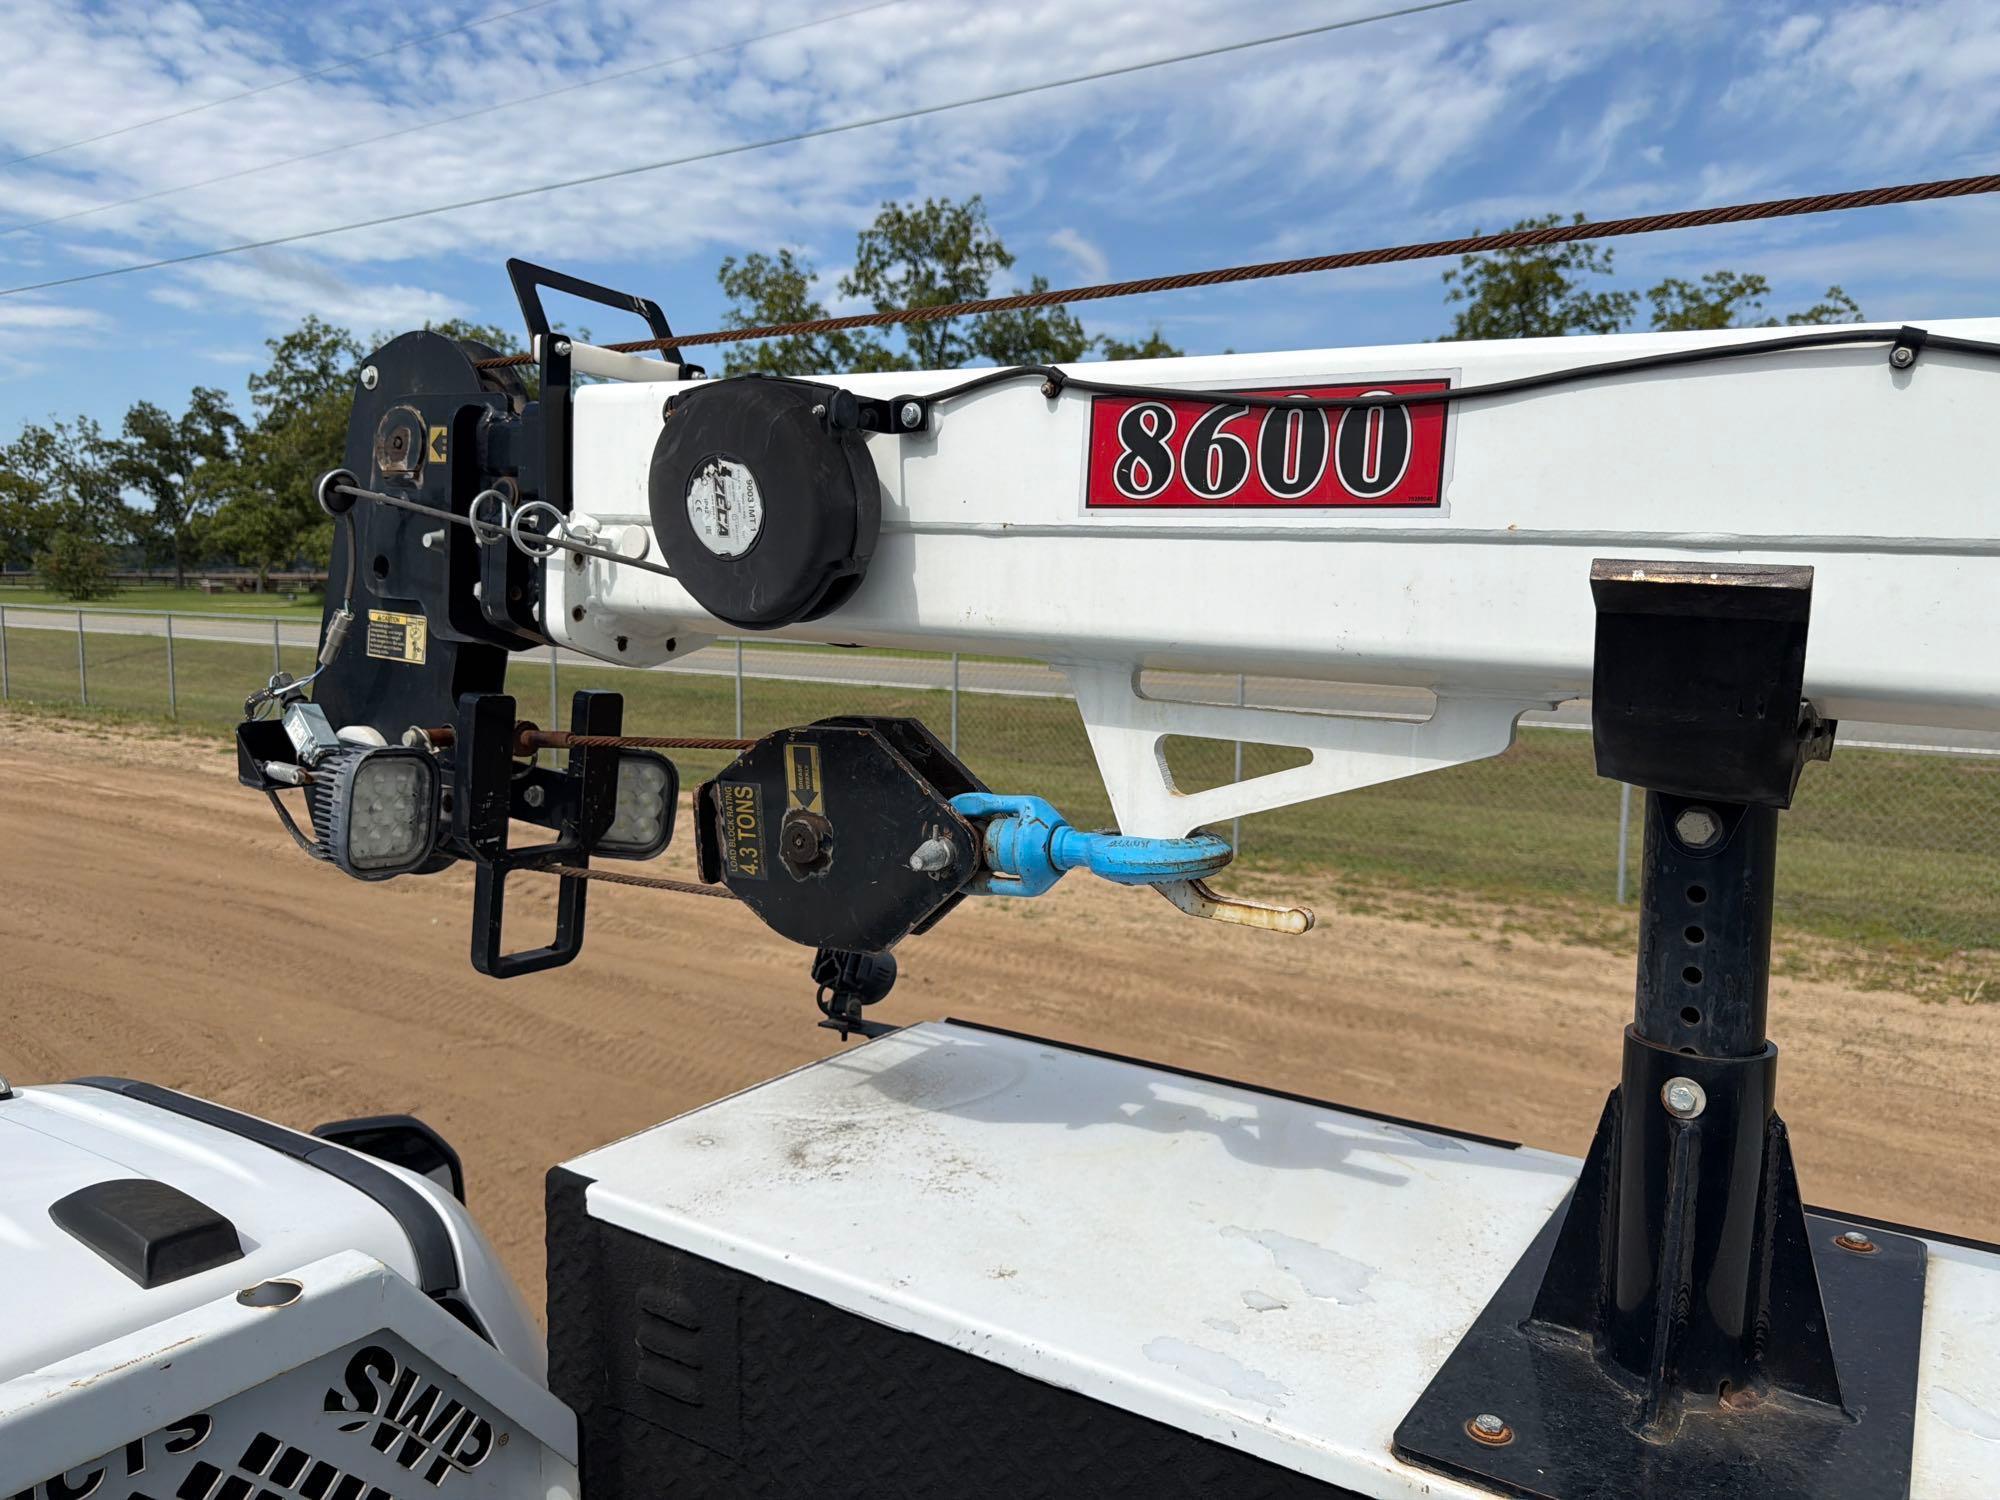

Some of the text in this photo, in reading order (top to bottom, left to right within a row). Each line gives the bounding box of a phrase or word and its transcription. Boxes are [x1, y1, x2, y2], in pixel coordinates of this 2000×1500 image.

[1112, 390, 1413, 500] 8600
[714, 478, 730, 536] ZECA
[746, 479, 754, 502] 9003
[724, 786, 738, 873] LOAD BLOCK RATING
[735, 785, 758, 876] 4.3 TONS
[323, 1345, 494, 1487] SWP
